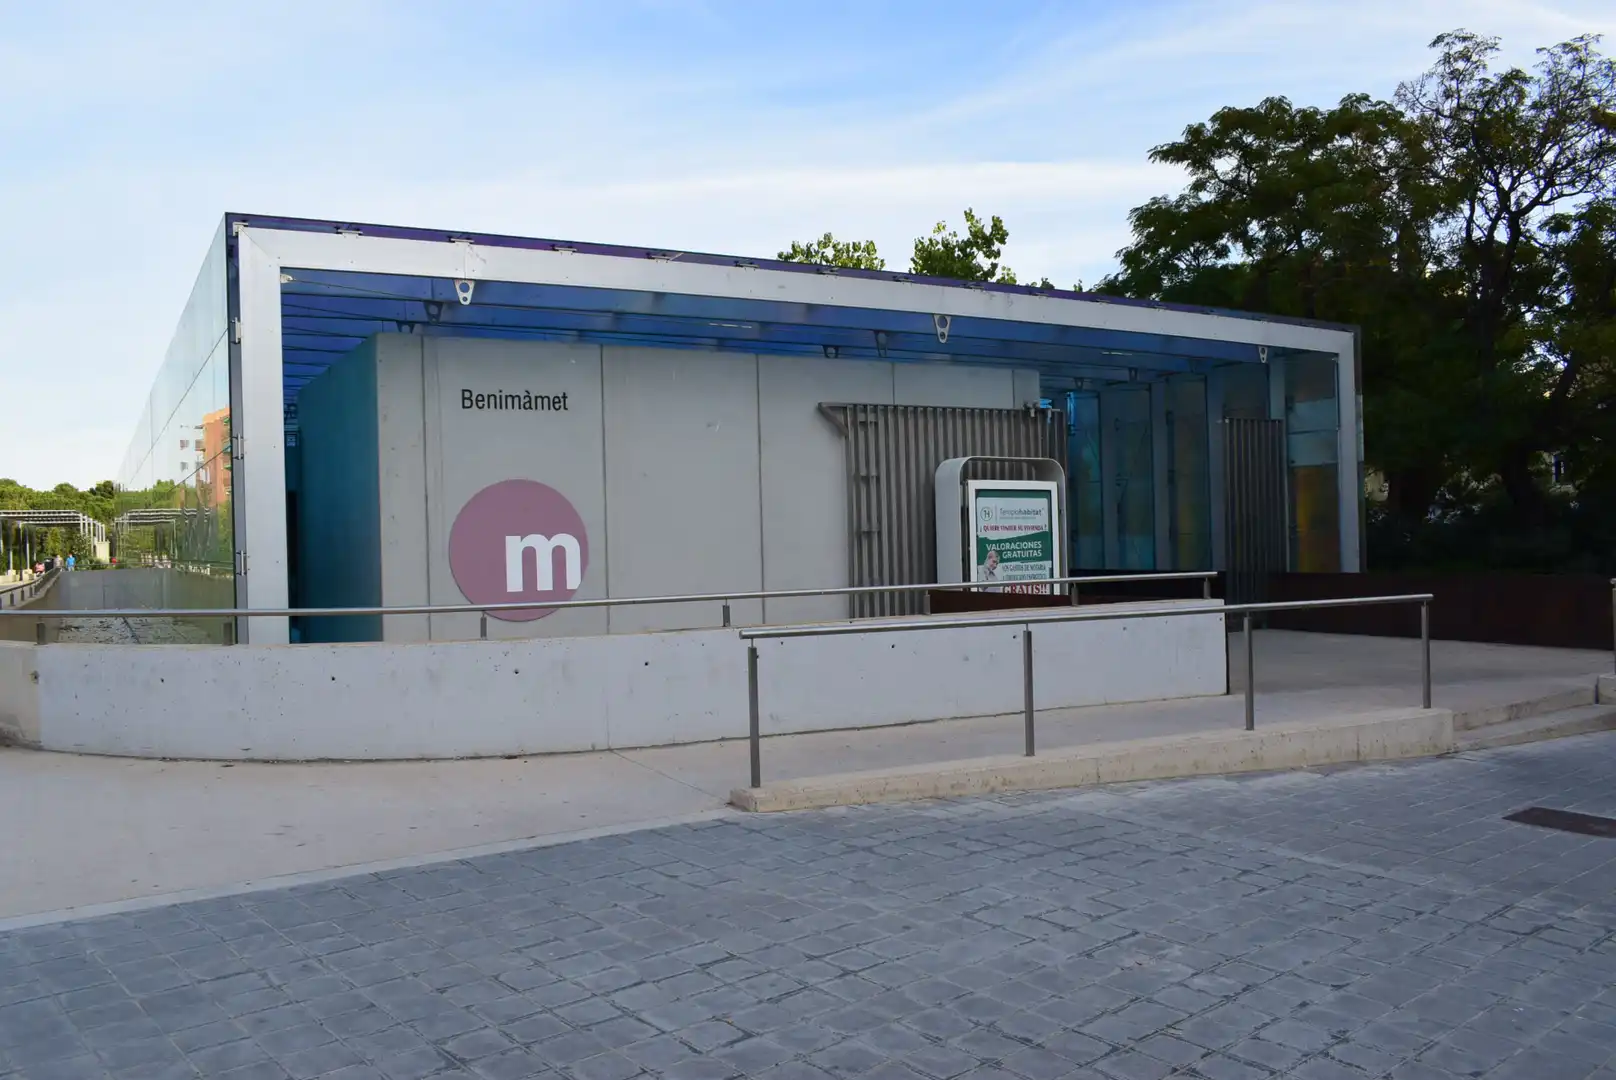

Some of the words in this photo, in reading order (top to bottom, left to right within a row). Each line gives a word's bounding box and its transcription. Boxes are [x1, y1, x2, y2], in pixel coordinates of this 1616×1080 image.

[461, 388, 569, 411] Benimàmet
[986, 541, 1042, 551] VALORACIONES
[1002, 549, 1042, 559] GRATUITAS
[505, 532, 582, 593] m
